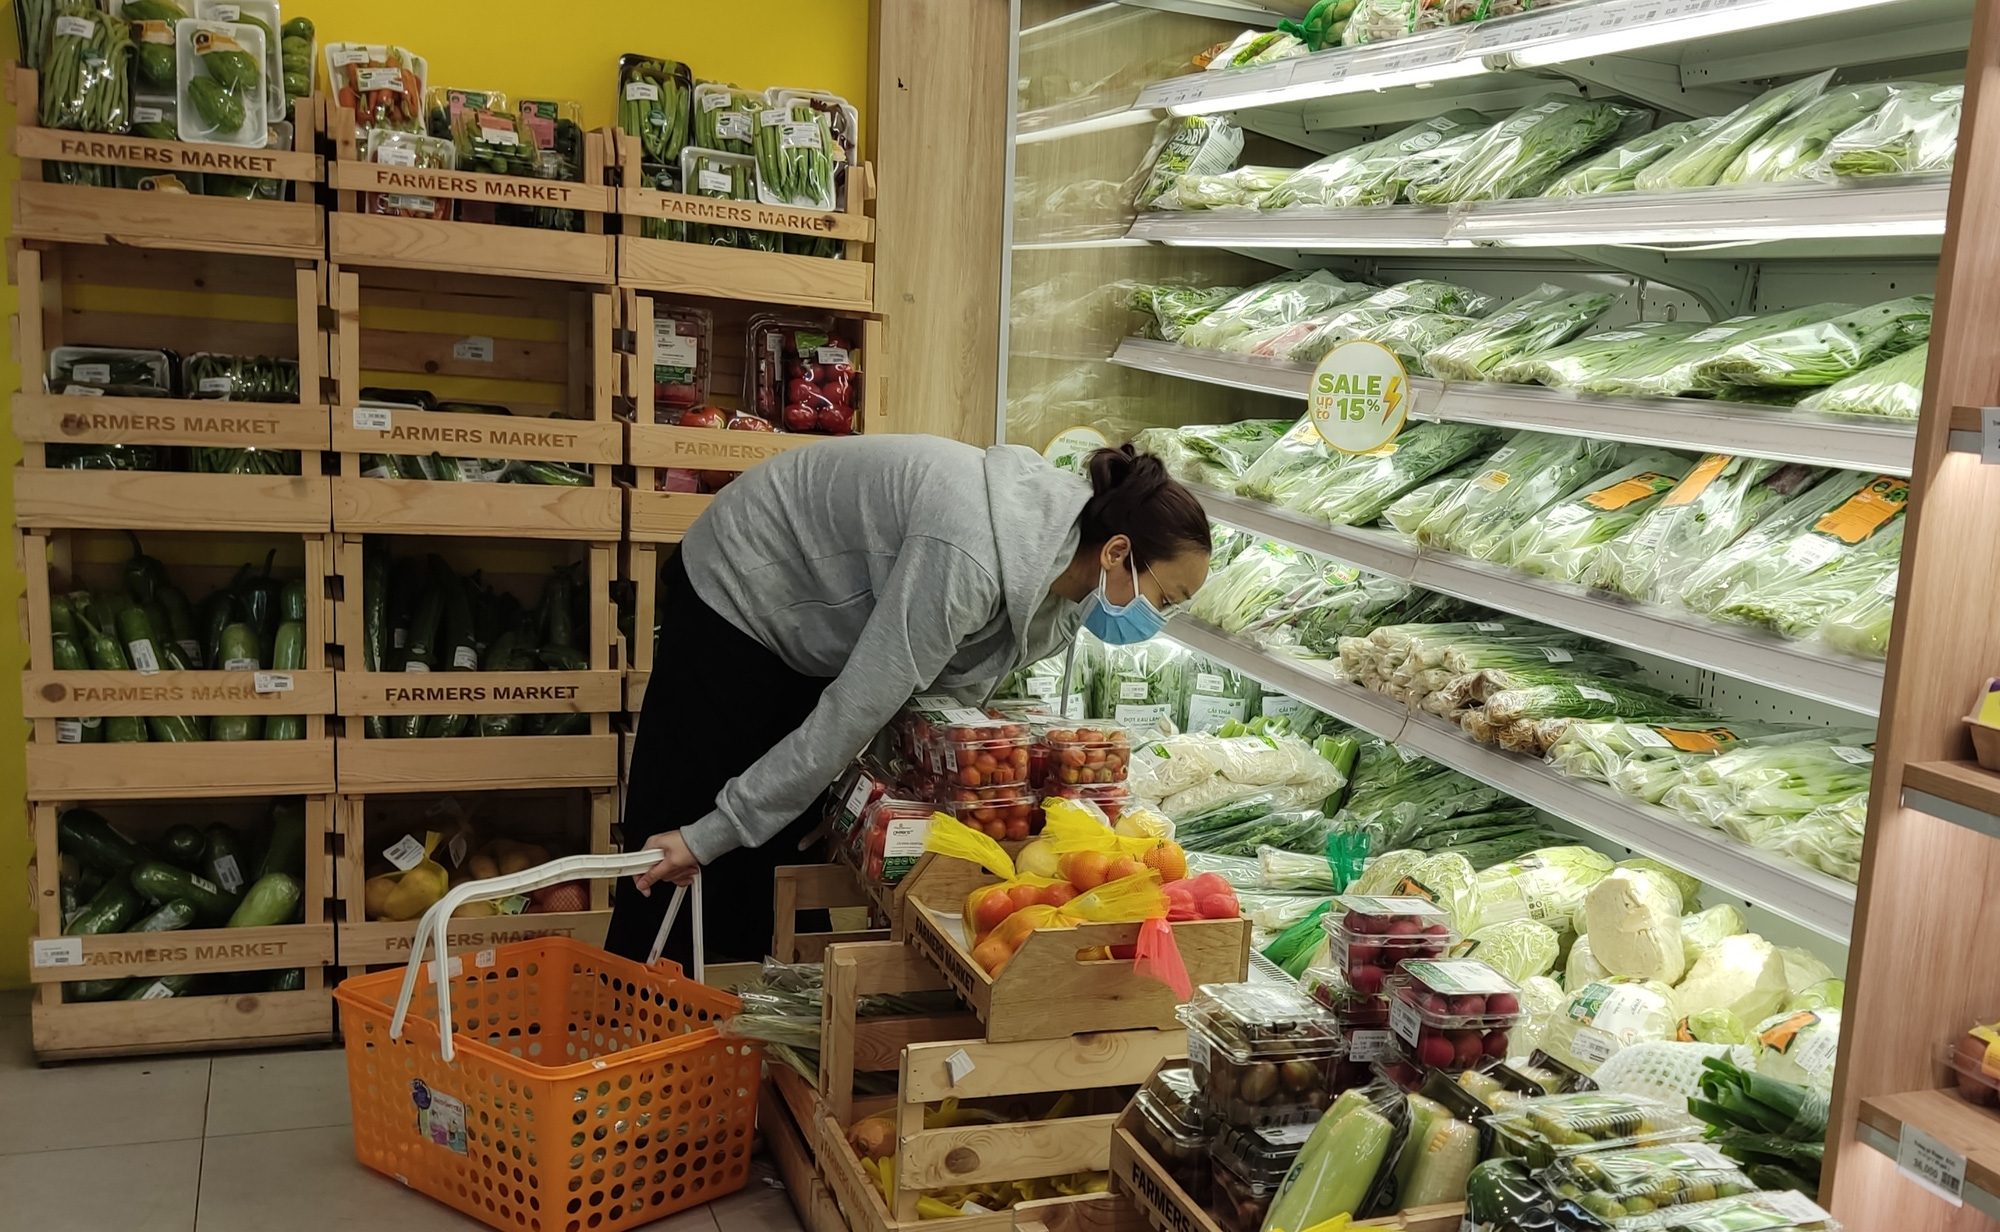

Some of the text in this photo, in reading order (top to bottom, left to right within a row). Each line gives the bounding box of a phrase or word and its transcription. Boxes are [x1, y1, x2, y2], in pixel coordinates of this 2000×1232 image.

[1174, 128, 1206, 145] BABY
[61, 139, 277, 173] FARMERS MARKET
[1168, 142, 1200, 156] SPINAC
[376, 170, 572, 203] FARMERS MARKET
[661, 198, 836, 233] FARMERS MARKET
[1317, 373, 1382, 395] SALE
[1315, 396, 1381, 421] up 15%
[1315, 409, 1330, 420] to
[62, 413, 280, 435] FARMERS MARKET
[379, 425, 578, 448] FARMERS MARKET
[674, 441, 765, 459] FARMERS
[73, 686, 184, 702] FARMERS
[385, 686, 579, 702] FARMERS MARKET
[385, 932, 484, 951] FAERS
[82, 947, 188, 967] FARMERS
[195, 941, 288, 962] MARKET
[915, 915, 976, 995] FARMERS MARKET
[1132, 1161, 1191, 1232] FARMERS
